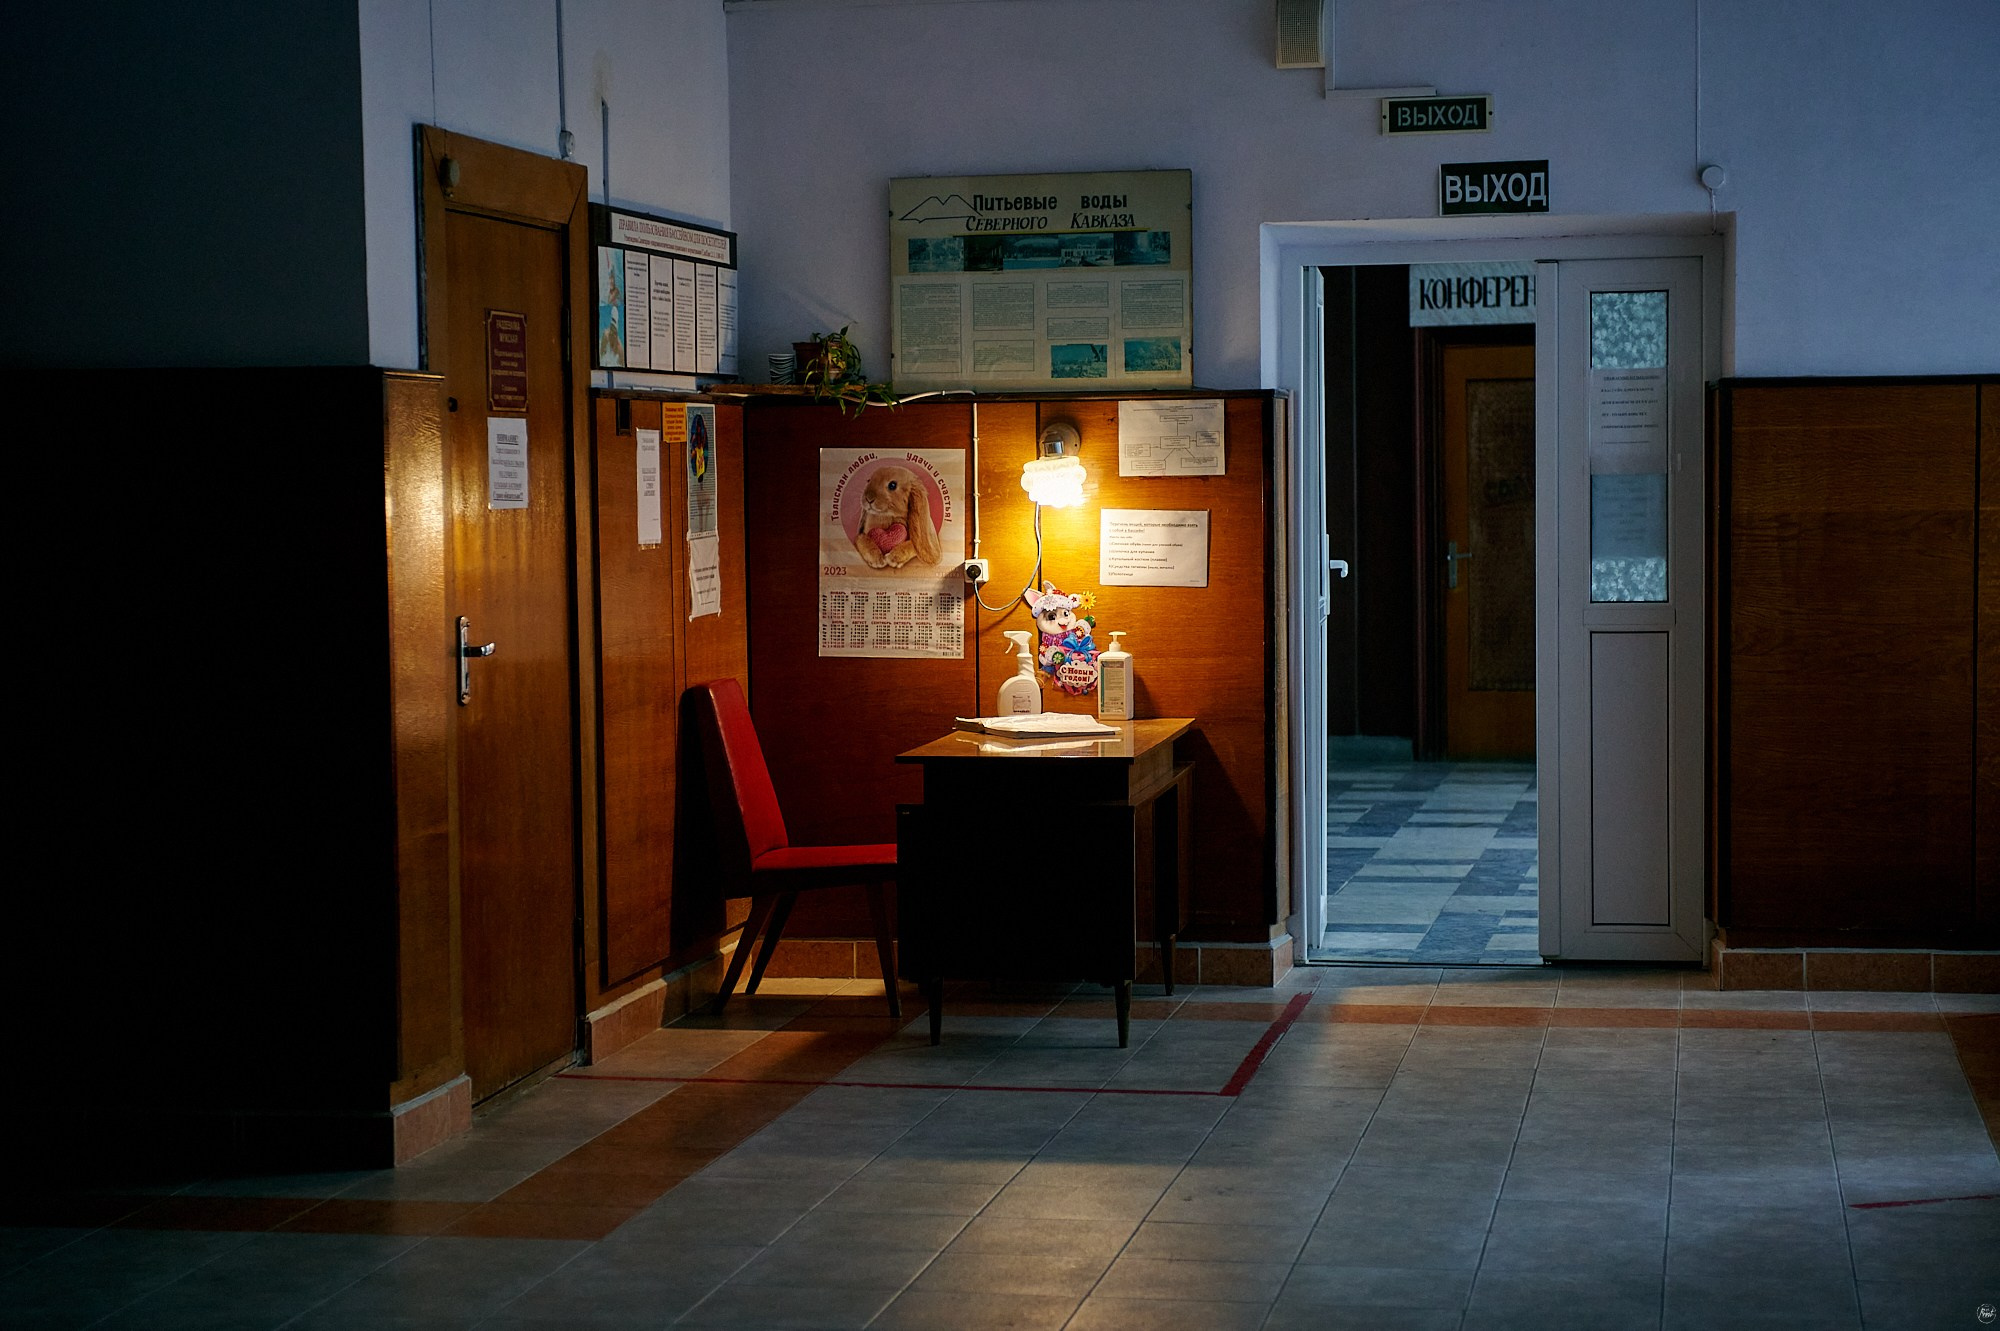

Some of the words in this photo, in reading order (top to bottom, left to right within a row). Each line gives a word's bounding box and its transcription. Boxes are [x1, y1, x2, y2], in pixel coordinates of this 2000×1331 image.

[1397, 104, 1478, 127] ВЫХОД
[973, 194, 1057, 212] Питьевые
[1081, 194, 1128, 210] воды
[1445, 172, 1547, 206] ВЫХОД
[1419, 274, 1536, 311] КОНФЕРЕН
[831, 474, 848, 521] Талисман
[848, 453, 878, 473] любви,
[906, 452, 933, 471] удачи
[933, 470, 940, 478] и
[938, 478, 952, 522] счастья!
[824, 566, 847, 576] 2023
[1061, 666, 1067, 674] С
